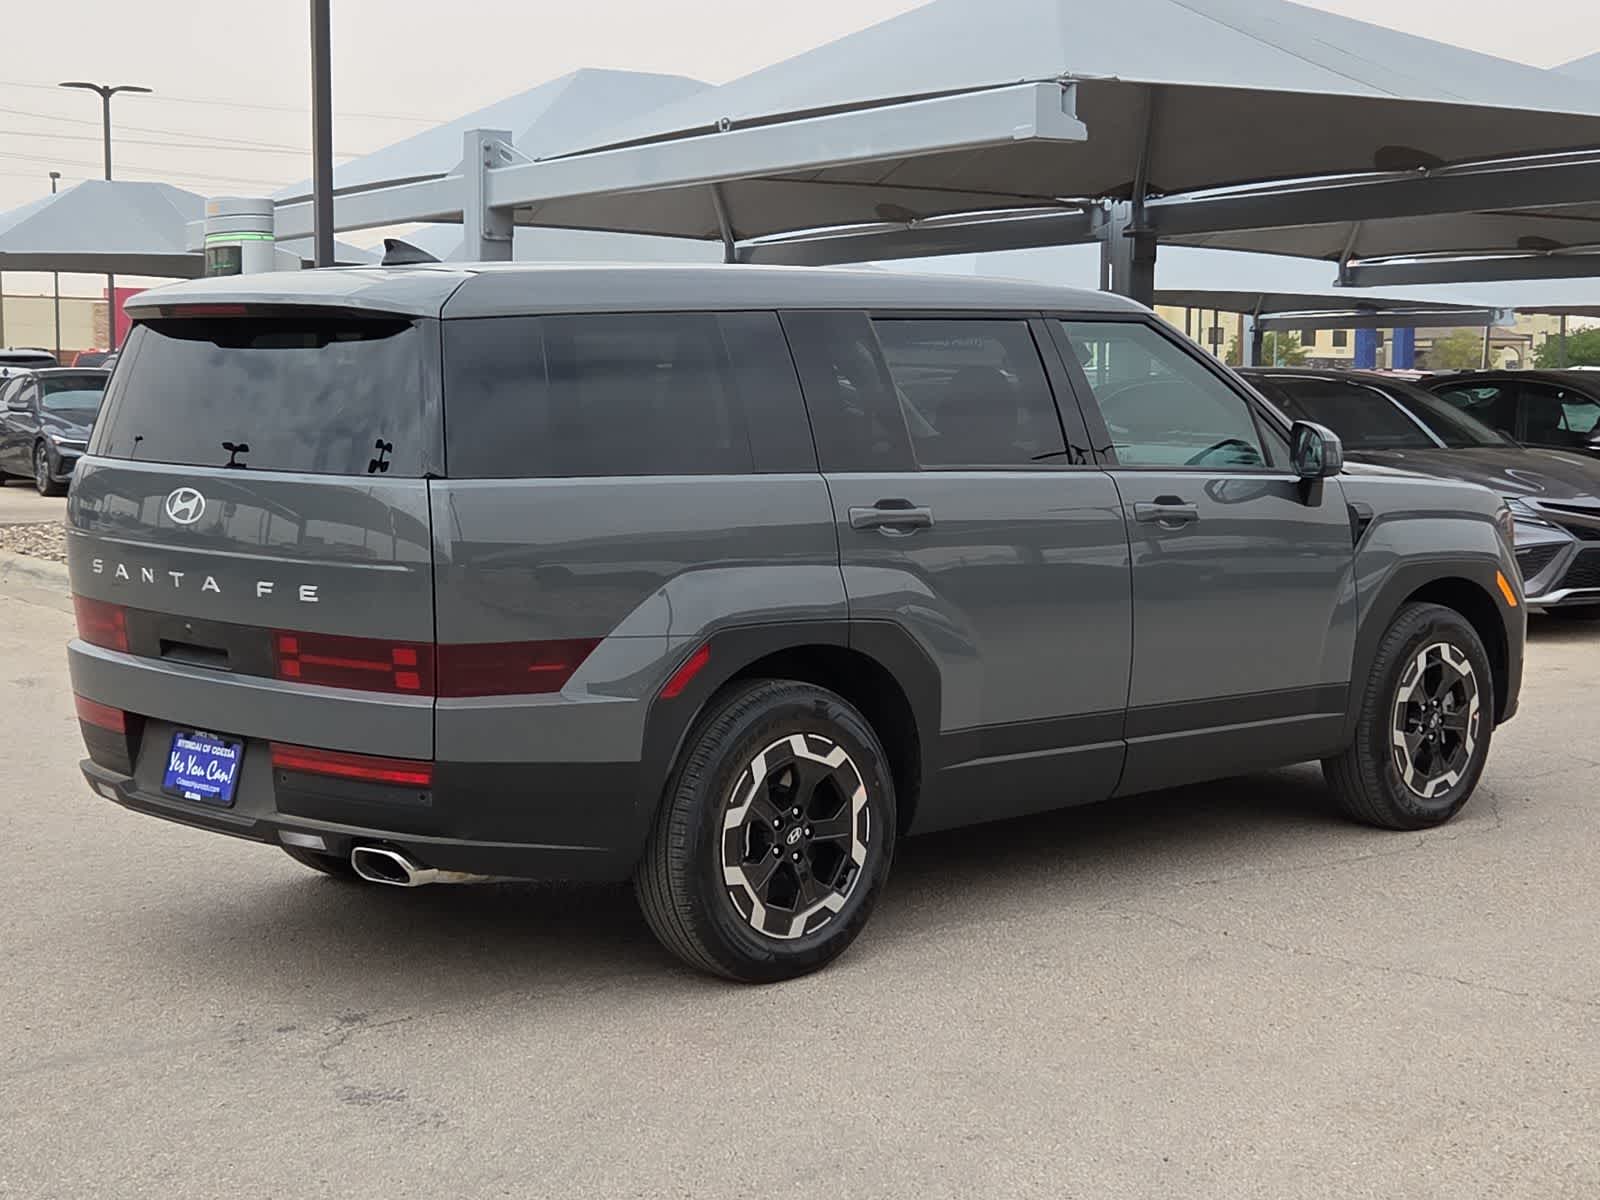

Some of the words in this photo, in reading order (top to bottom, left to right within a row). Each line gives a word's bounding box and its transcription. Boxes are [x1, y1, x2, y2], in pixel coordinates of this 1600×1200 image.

[92, 559, 221, 593] SANTA
[256, 581, 319, 602] FE
[202, 744, 212, 753] OF
[169, 751, 185, 773] Yes
[186, 755, 205, 777] You
[206, 760, 236, 784] Can!
